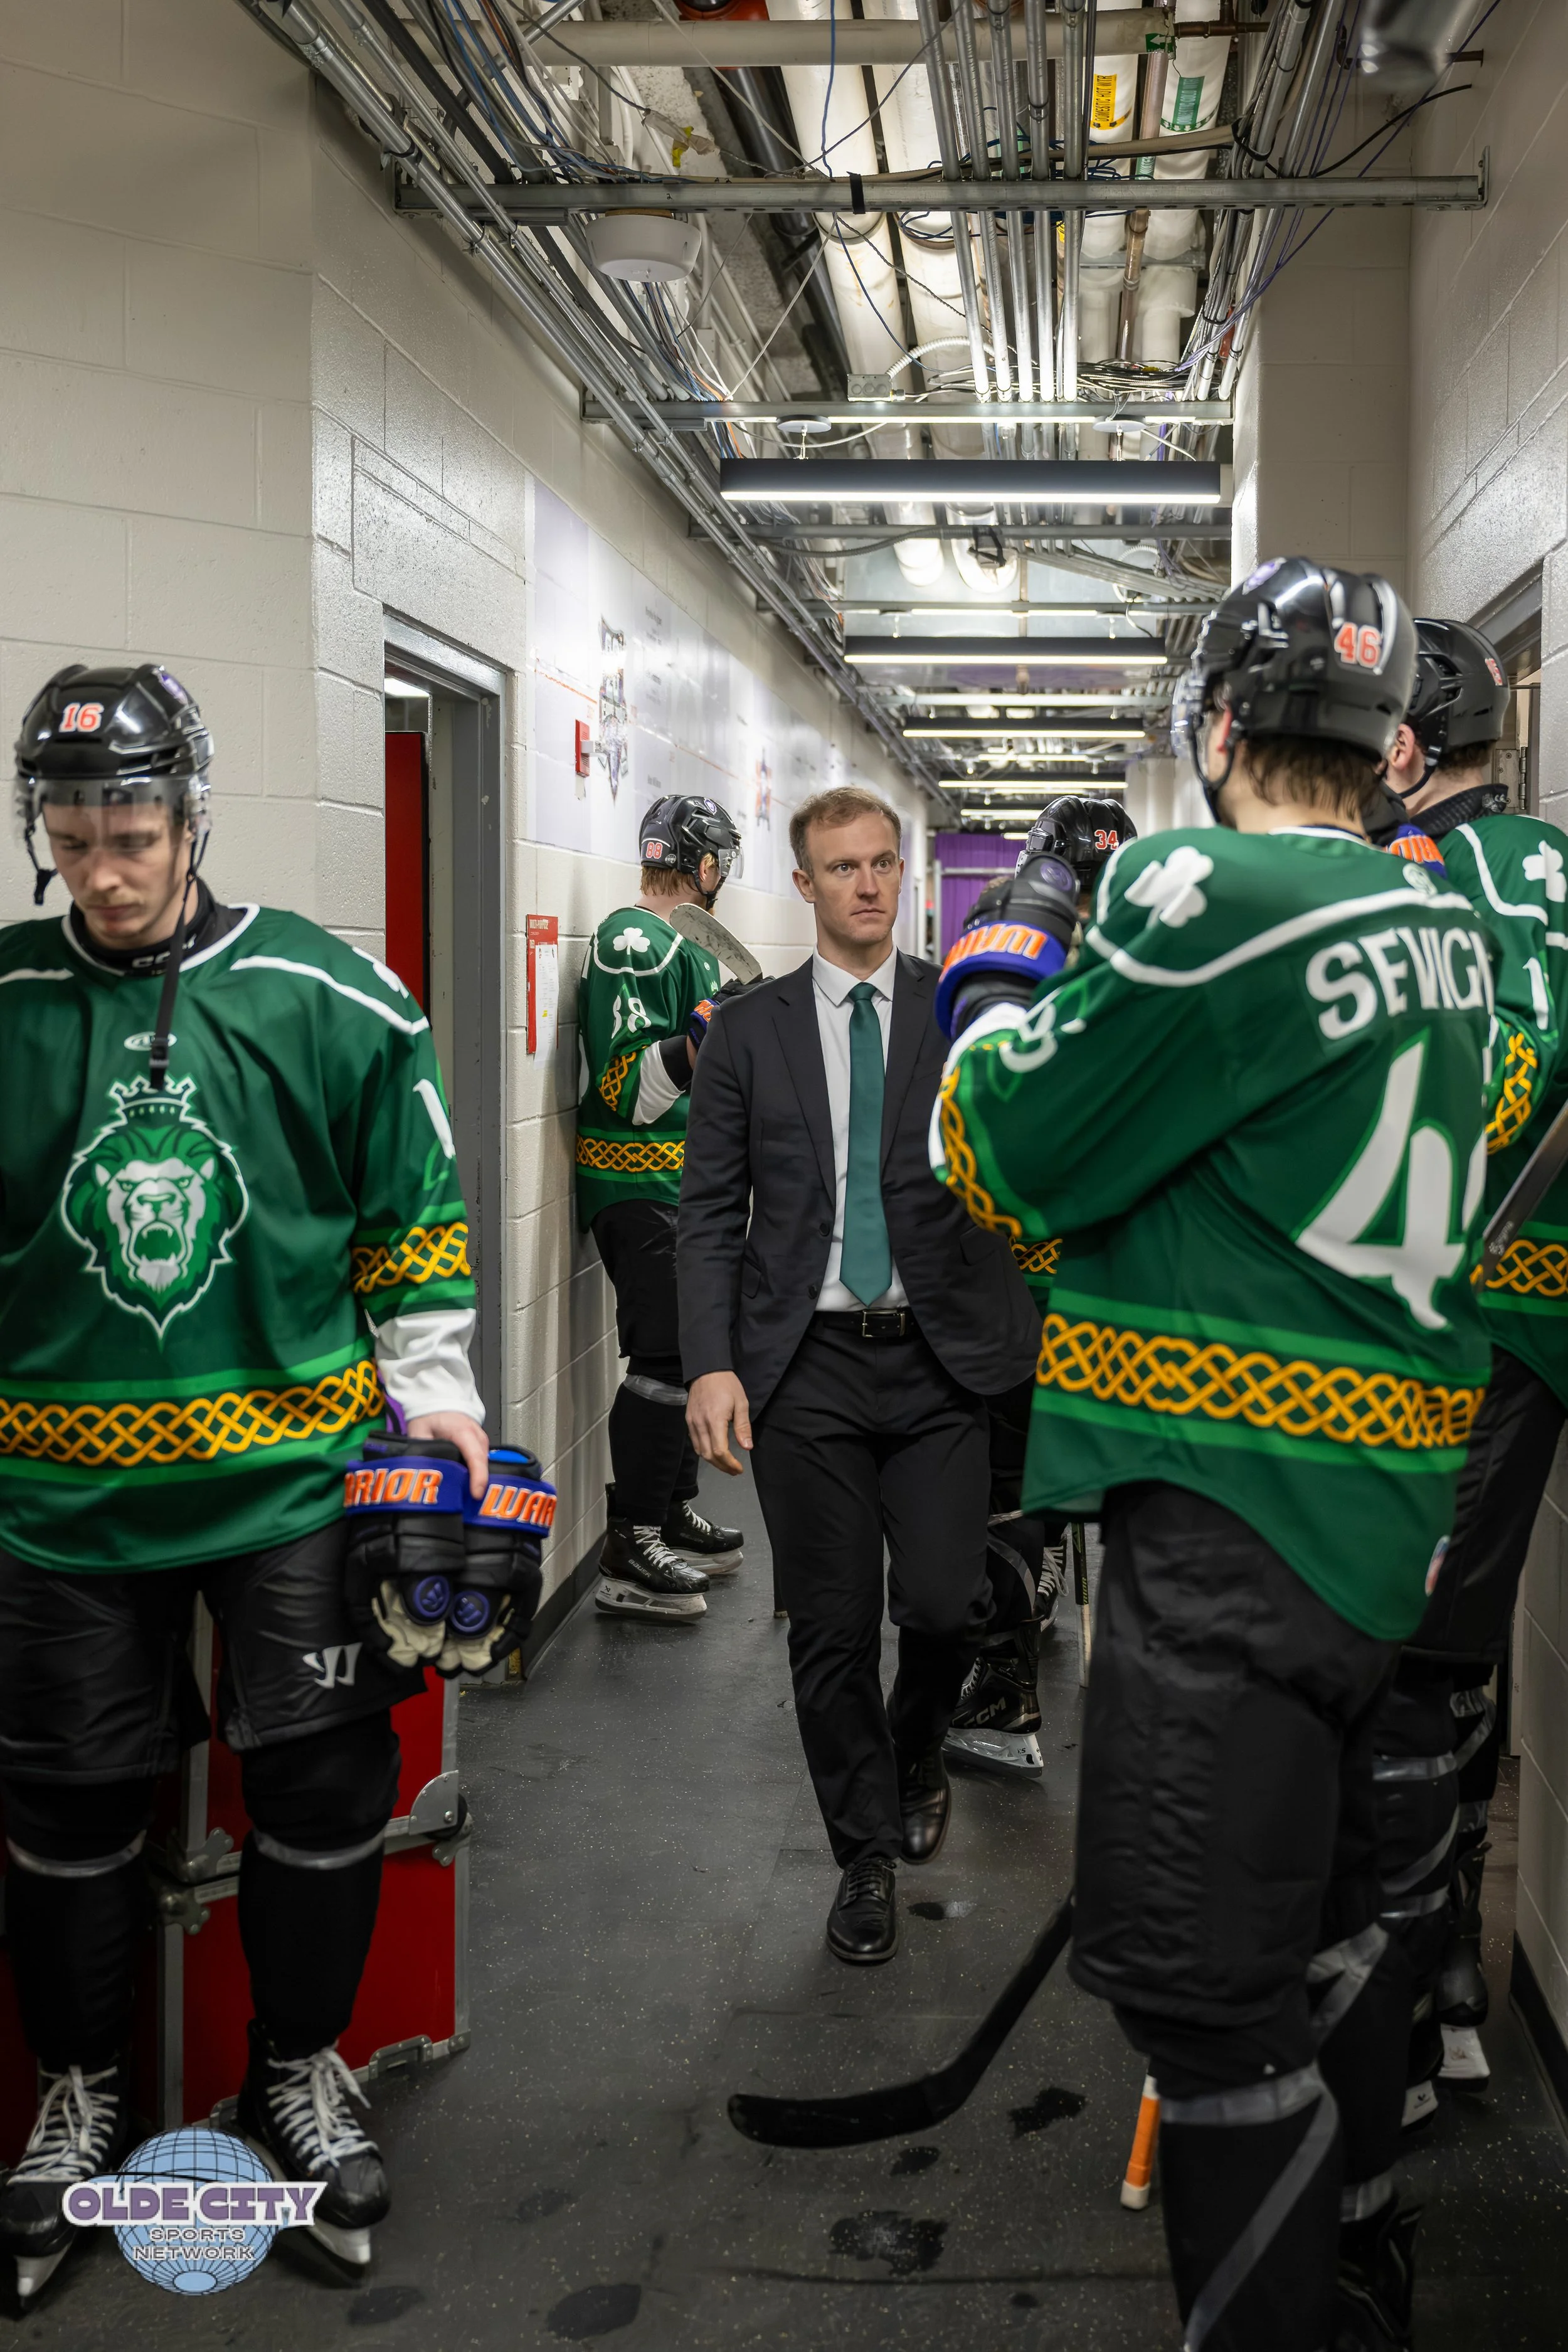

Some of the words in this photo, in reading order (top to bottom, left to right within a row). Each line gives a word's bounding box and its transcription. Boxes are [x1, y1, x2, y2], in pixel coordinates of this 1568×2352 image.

[1097, 75, 1113, 87] WTR
[1096, 87, 1111, 98] HOT
[1094, 98, 1111, 122] DOMESTIC
[1334, 622, 1382, 669] 46
[58, 702, 105, 733] 16
[1094, 829, 1119, 850] 34
[645, 842, 663, 859] 88
[628, 1558, 652, 1579] BAUER
